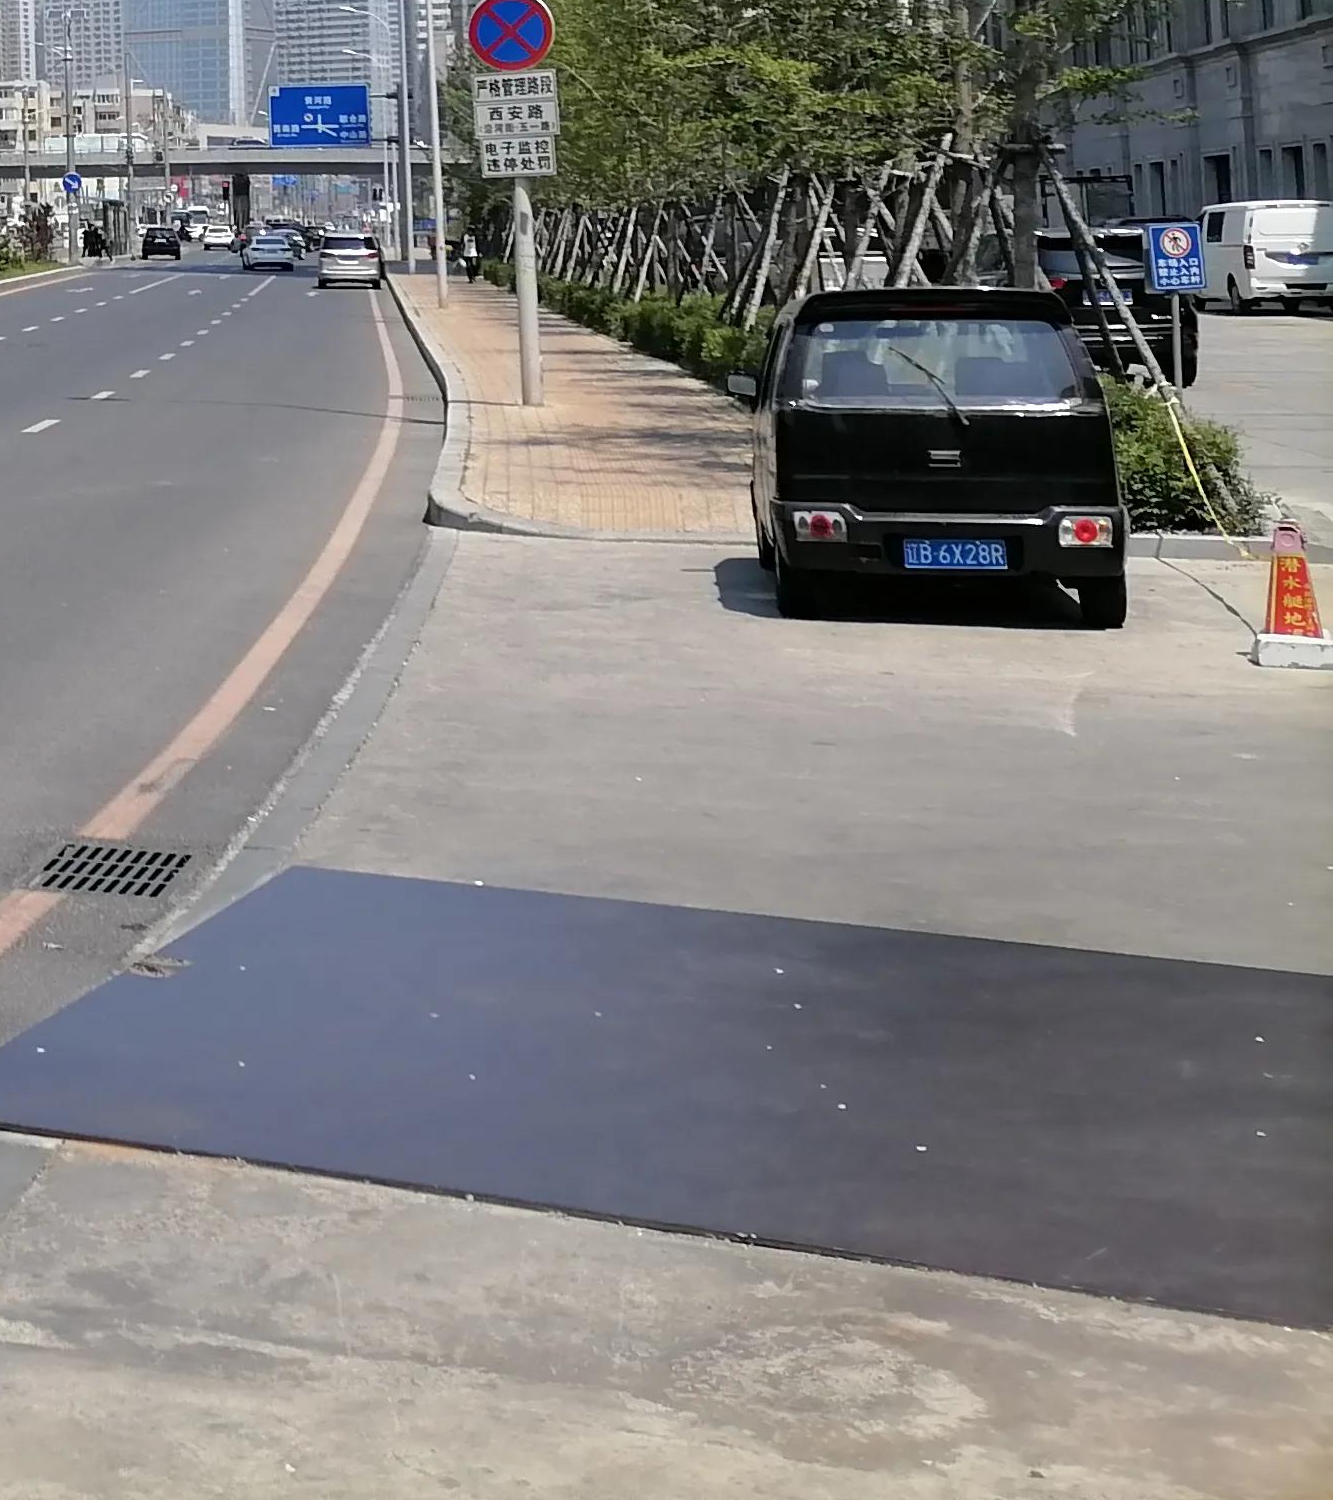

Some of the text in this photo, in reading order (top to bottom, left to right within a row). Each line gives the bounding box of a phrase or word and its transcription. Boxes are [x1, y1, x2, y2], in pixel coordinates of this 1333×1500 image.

[476, 76, 553, 98] 严格管理路段
[487, 104, 543, 120] 西安路
[339, 130, 367, 139] 中山路
[485, 140, 550, 156] 电子监控
[486, 156, 551, 172] 违停处罚
[1157, 258, 1199, 267] 车场入口
[1158, 267, 1200, 277] 禁止入内
